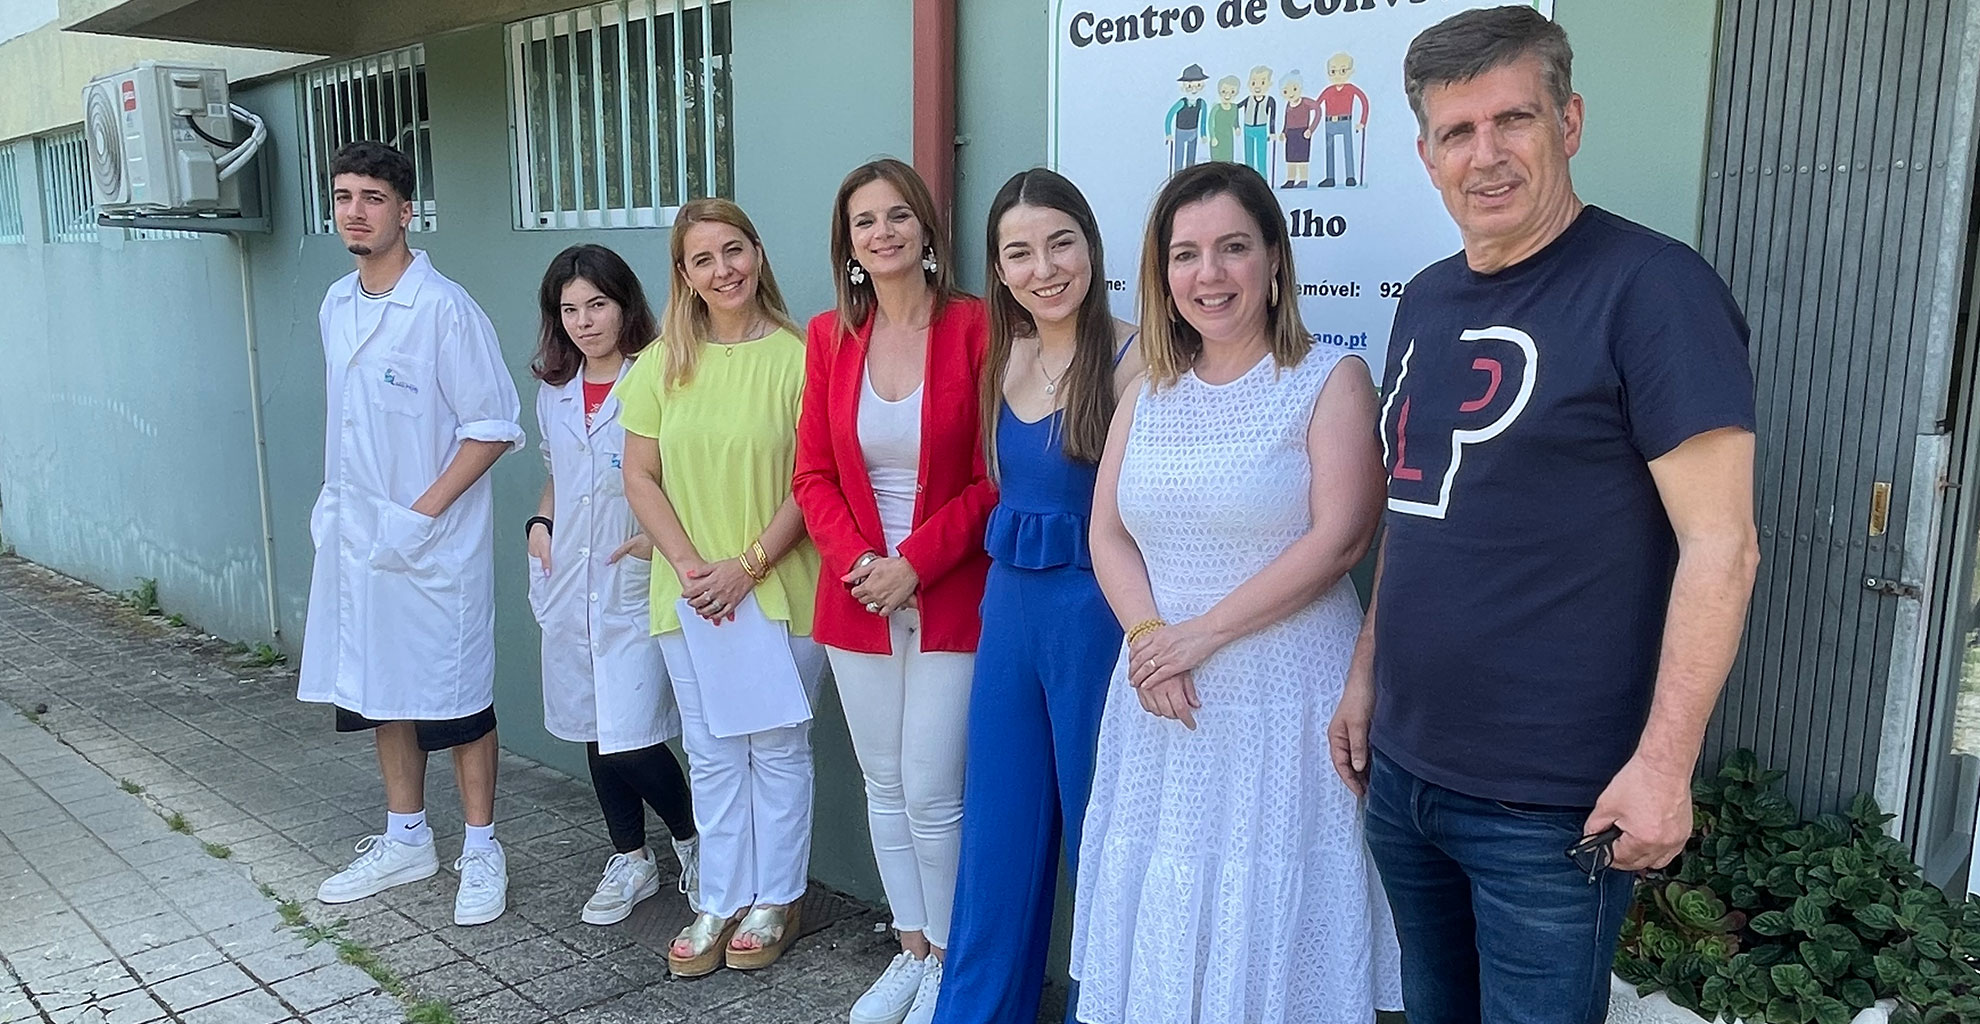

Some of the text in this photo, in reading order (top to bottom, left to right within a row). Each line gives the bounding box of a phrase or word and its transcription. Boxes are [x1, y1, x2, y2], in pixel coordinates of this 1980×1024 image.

[1070, 5, 1205, 48] Centro
[1216, 0, 1268, 28] de
[1289, 209, 1347, 238] lho
[1105, 280, 1409, 298] ne: emóvel: 92
